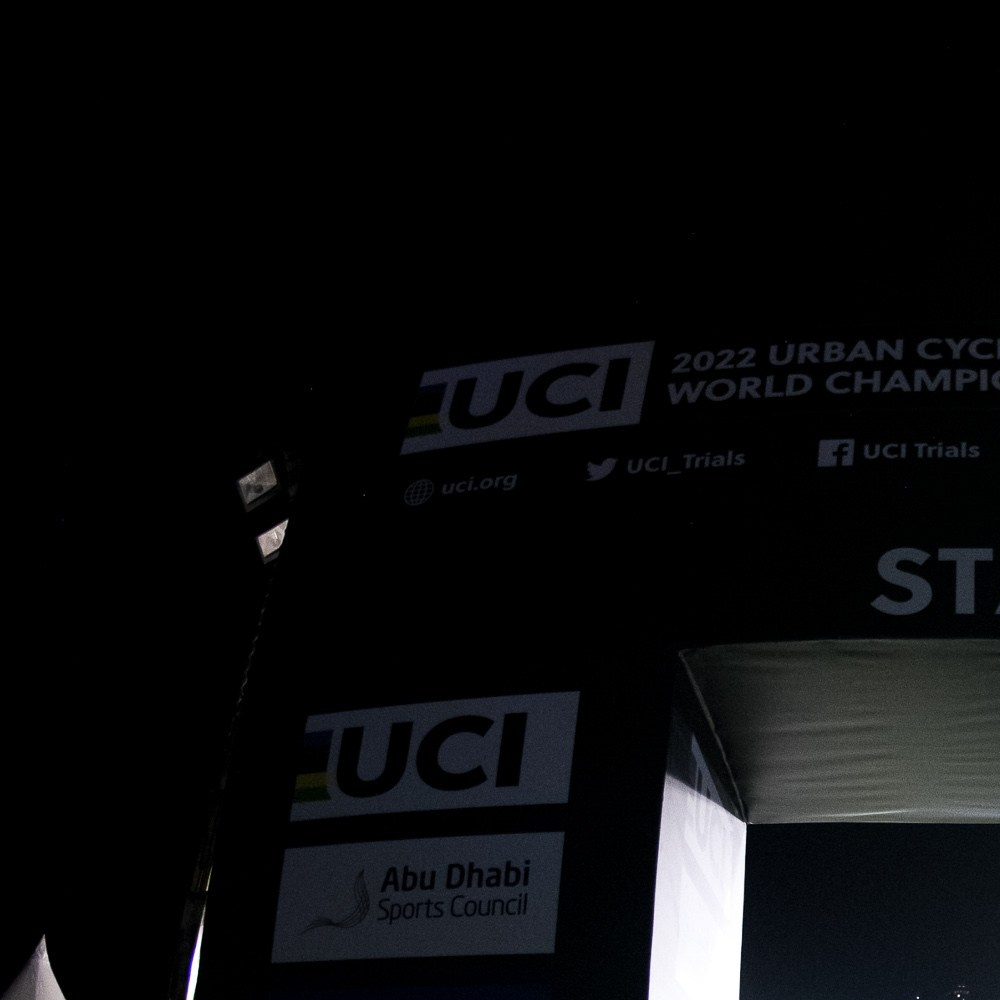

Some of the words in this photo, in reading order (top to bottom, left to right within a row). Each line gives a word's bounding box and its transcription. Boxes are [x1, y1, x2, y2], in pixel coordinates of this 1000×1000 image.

[671, 347, 757, 375] 2022
[768, 338, 905, 367] URBAN
[448, 356, 633, 430] UCI
[666, 371, 814, 406] WORLD
[626, 449, 747, 475] UCI_Trials
[863, 442, 907, 460] UCI
[914, 441, 980, 460] Trials
[440, 472, 518, 495] uci.org
[336, 712, 528, 798] UCI
[381, 866, 436, 892] Abu
[445, 859, 531, 889] Dhabi
[377, 897, 444, 925] Sports
[450, 893, 528, 919] Council
